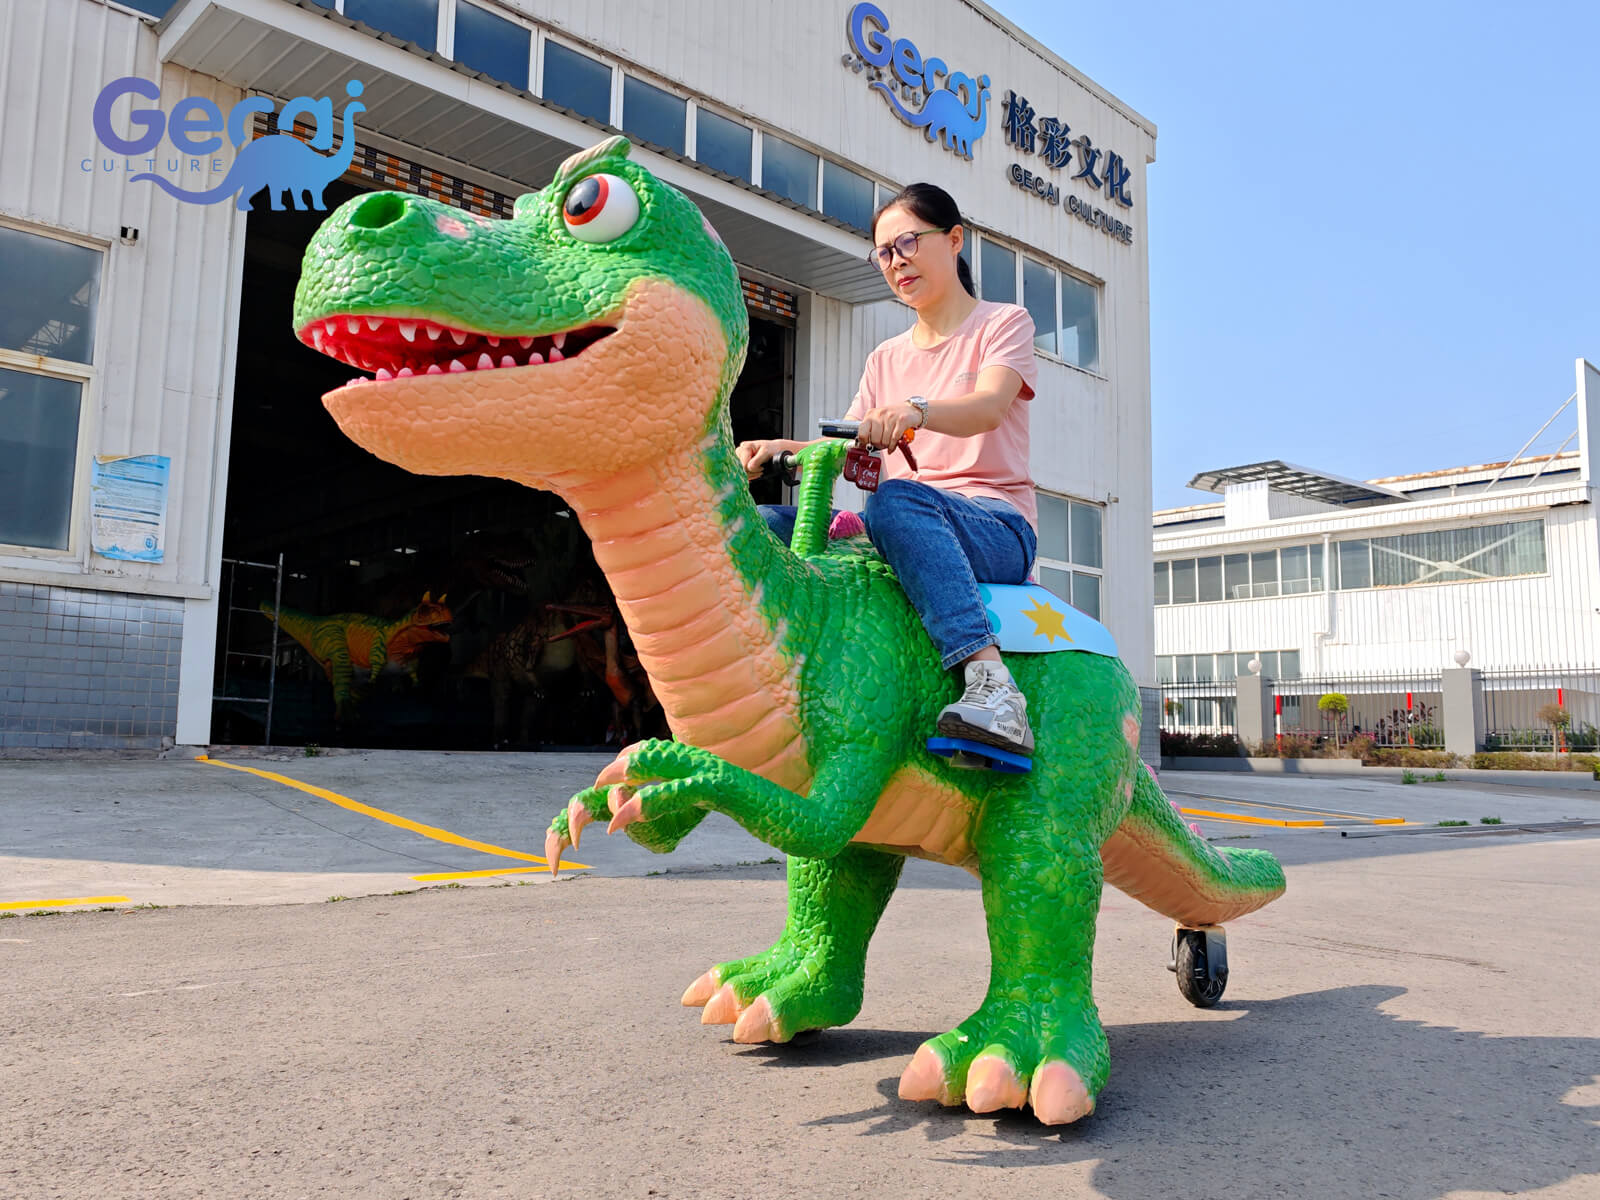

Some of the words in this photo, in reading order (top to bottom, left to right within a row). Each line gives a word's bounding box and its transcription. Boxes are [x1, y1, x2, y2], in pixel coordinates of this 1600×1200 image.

[1001, 89, 1134, 208] 格彩文化
[1007, 162, 1060, 206] GECAI
[1064, 194, 1134, 245] CULTURE
